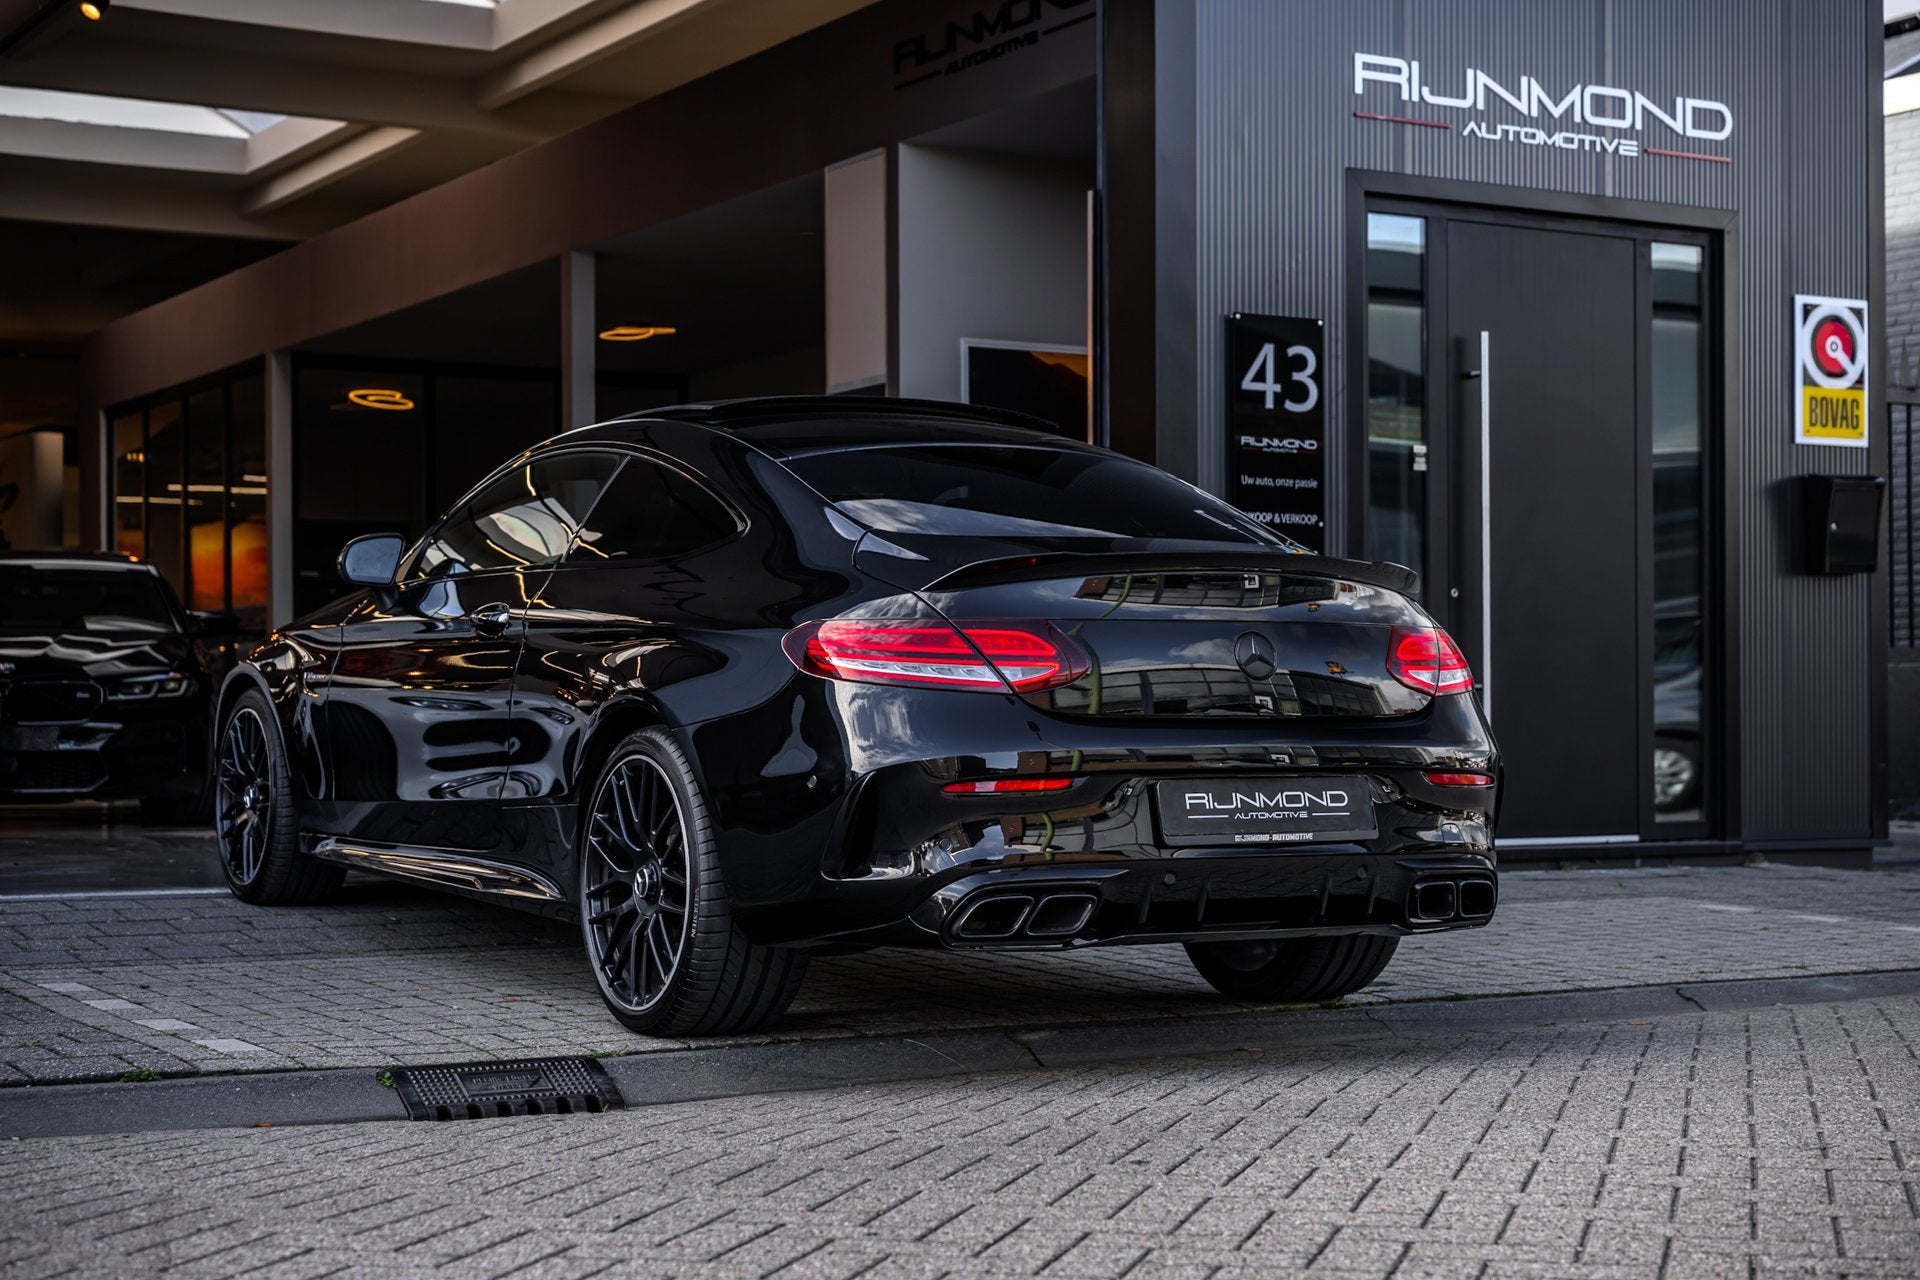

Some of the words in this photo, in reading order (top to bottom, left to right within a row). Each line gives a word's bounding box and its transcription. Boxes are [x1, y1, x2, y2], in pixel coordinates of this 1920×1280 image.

[1353, 52, 1733, 141] RIJNMOND
[1462, 120, 1640, 157] AUTOMOTIVE
[1241, 343, 1318, 412] 43
[1809, 396, 1860, 431] BOVAG
[1240, 435, 1318, 450] RIJNMOND
[1241, 474, 1254, 485] Uw
[1255, 476, 1275, 487] auto,
[1275, 477, 1294, 488] onze
[1294, 477, 1318, 490] passie
[1273, 513, 1281, 524] &
[1281, 513, 1318, 526] VERKOOP
[1184, 790, 1349, 810] RIJNMOND
[1234, 811, 1309, 820] AUTOMOTIVE
